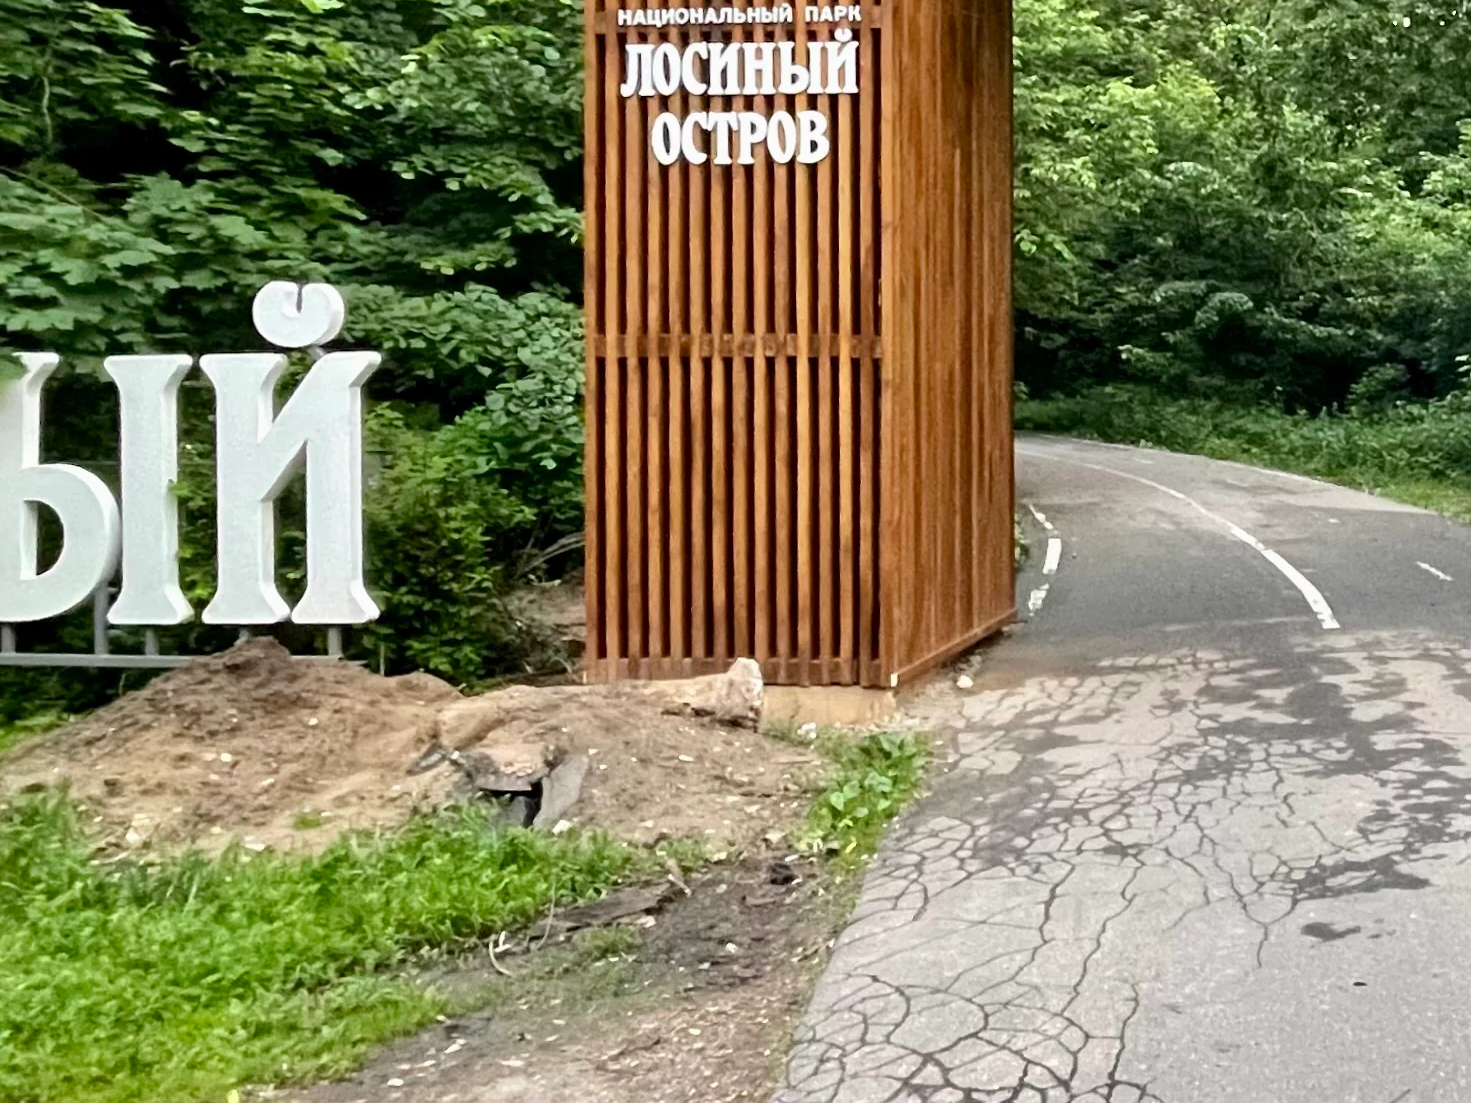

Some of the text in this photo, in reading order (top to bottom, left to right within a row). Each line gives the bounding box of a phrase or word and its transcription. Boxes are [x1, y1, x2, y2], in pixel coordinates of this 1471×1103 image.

[617, 3, 862, 28] НАЦИОНАЛЬНЫЙ ПАРК
[620, 27, 859, 97] ЛОСИНЫЙ
[651, 110, 830, 165] ОСТРОВ
